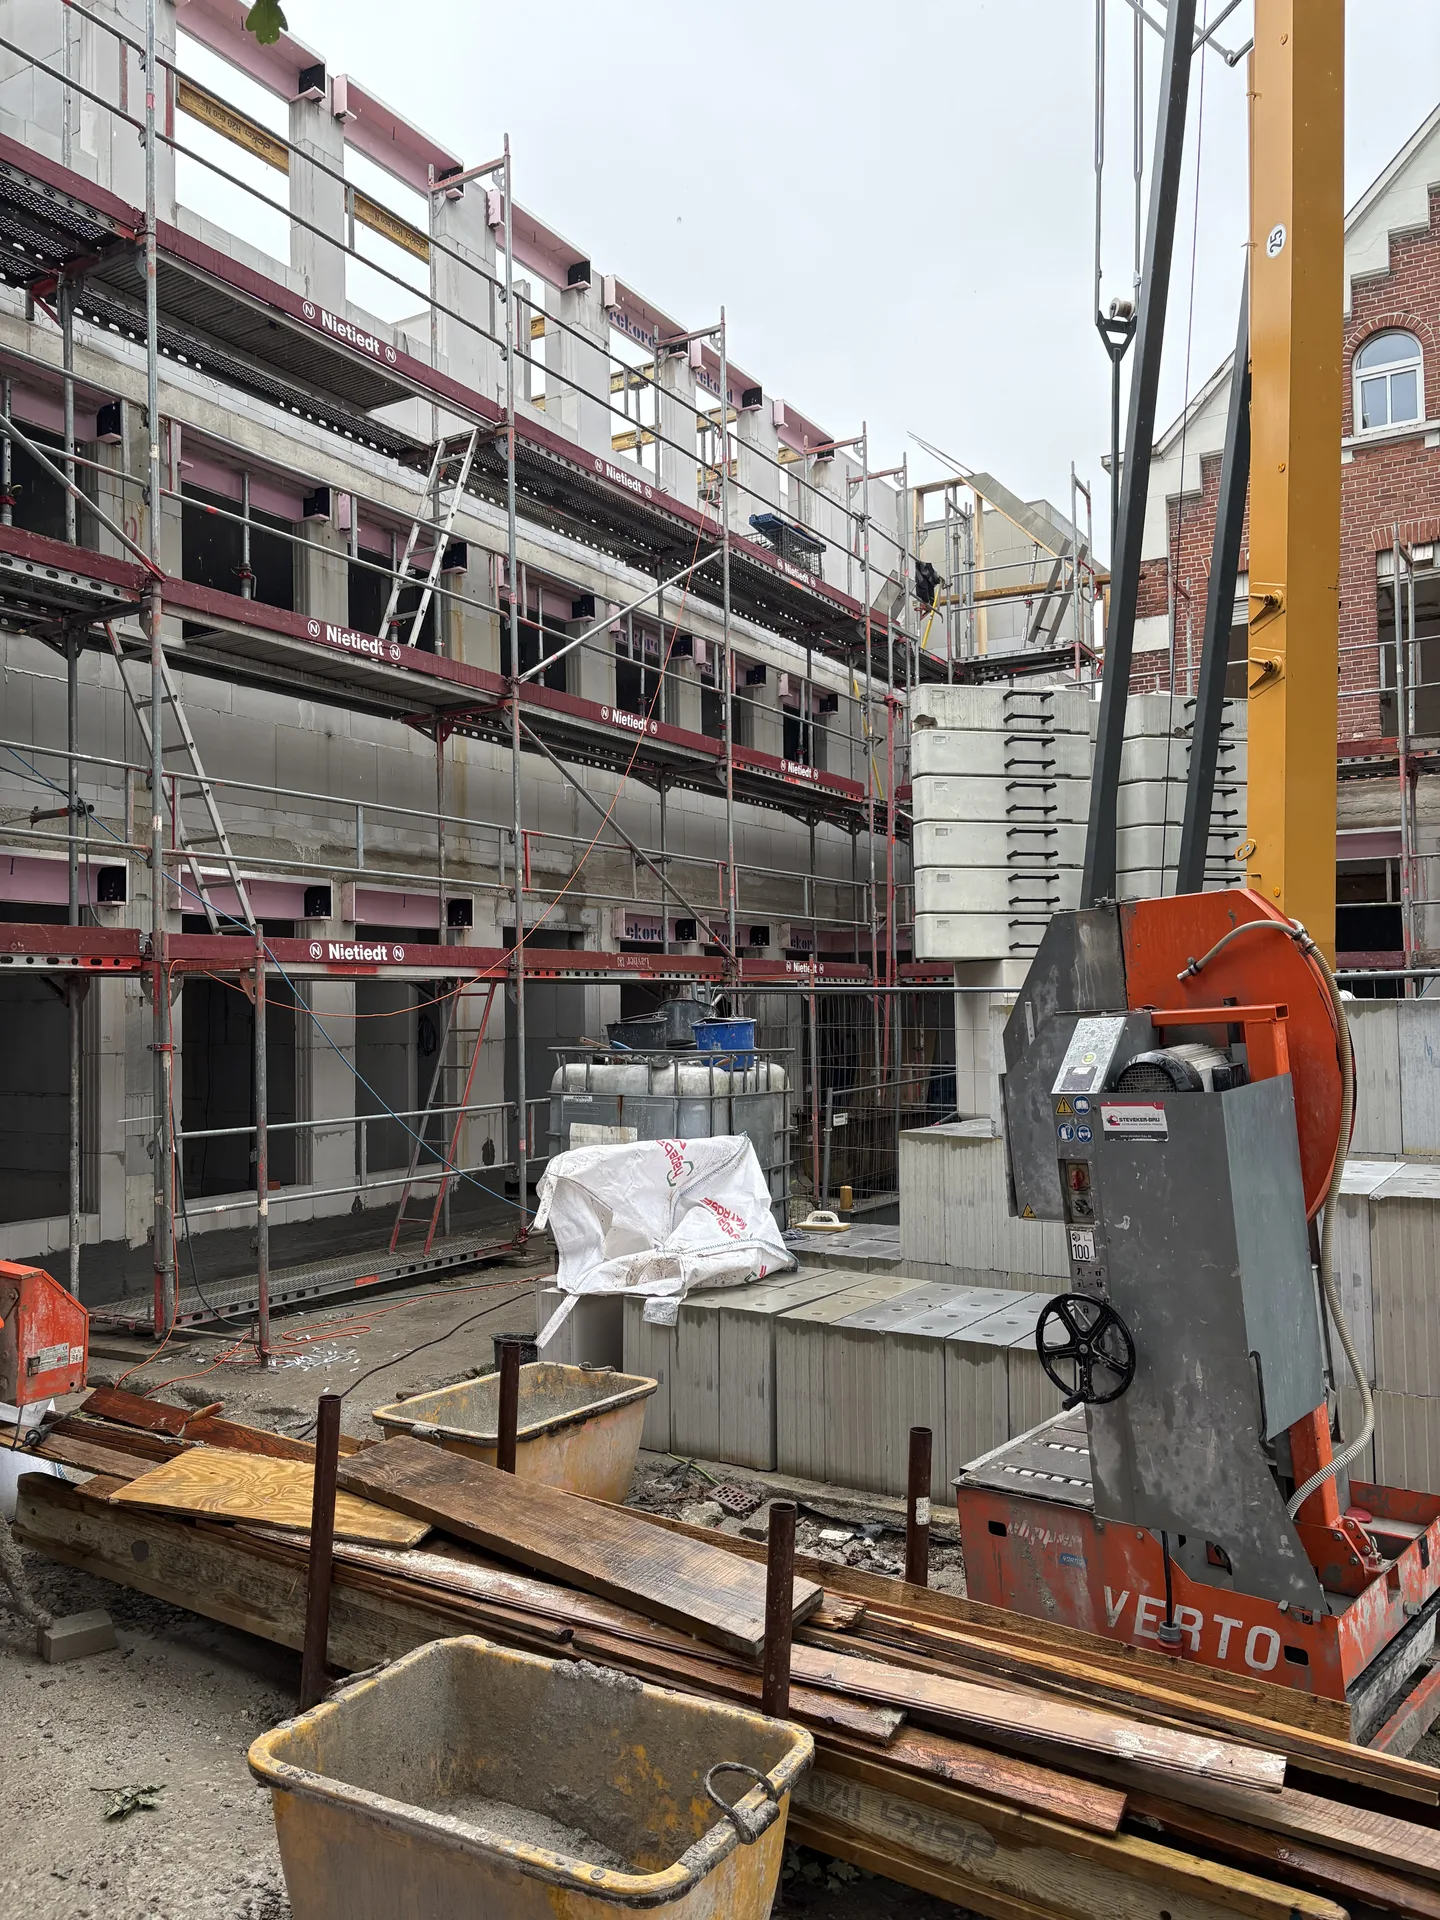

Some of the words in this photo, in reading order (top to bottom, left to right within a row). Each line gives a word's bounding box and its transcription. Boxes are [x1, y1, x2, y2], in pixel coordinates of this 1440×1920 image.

[1269, 229, 1283, 253] 25
[321, 309, 380, 355] Nietiedt
[605, 463, 643, 494] Nietiedt
[784, 562, 810, 585] Nietiedt
[326, 624, 385, 657] Nietiedt
[611, 709, 648, 732] Nietiedt
[787, 761, 812, 779] Nietiedt
[328, 943, 388, 961] Nietiedt
[1072, 1243, 1090, 1260] 100
[1103, 1585, 1281, 1672] VERTO
